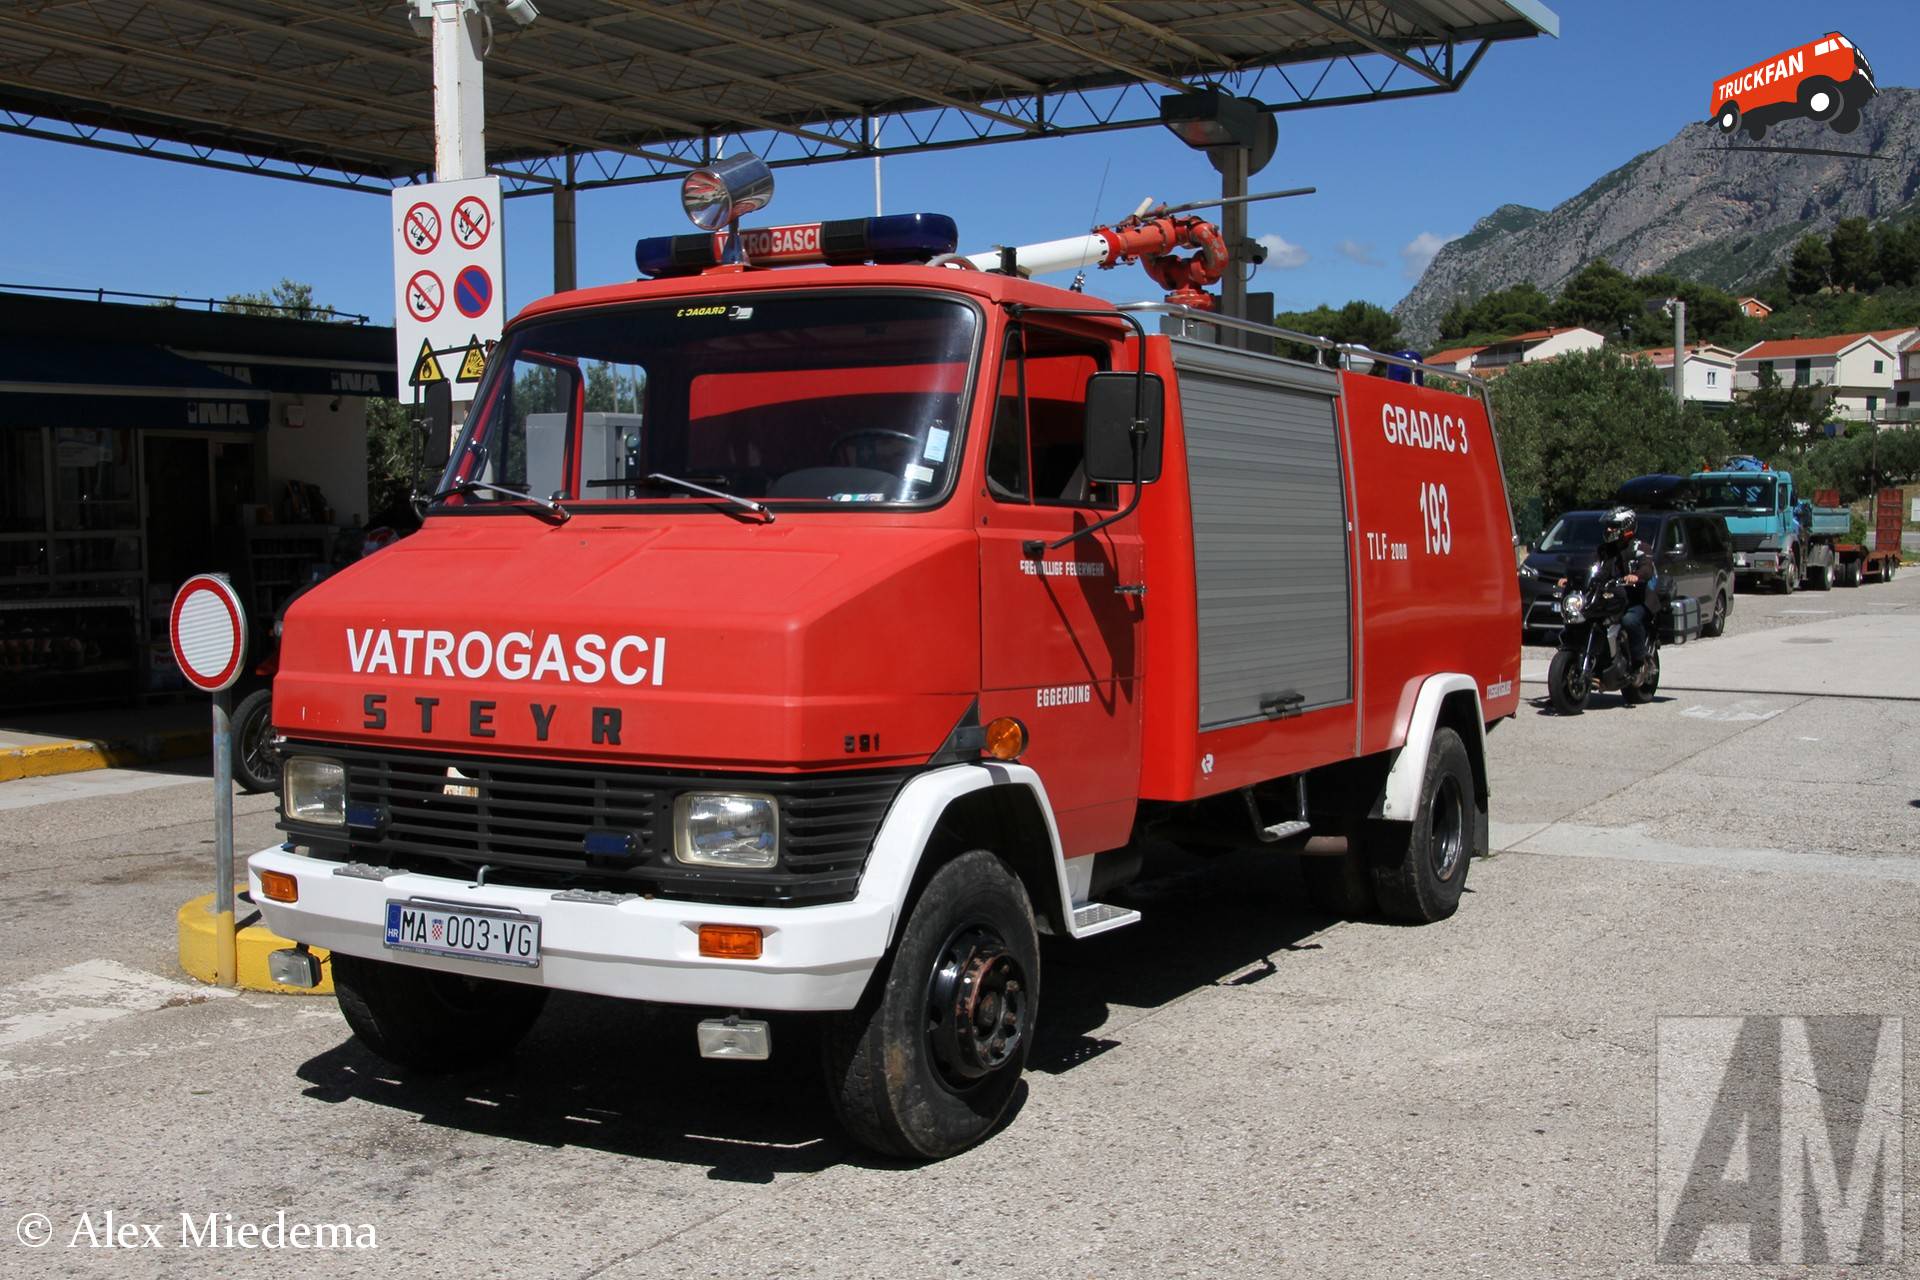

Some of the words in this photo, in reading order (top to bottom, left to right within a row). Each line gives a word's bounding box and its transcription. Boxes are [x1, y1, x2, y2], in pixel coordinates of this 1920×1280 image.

[718, 228, 821, 254] VTROGASCI
[1382, 403, 1456, 452] GRADAC
[1458, 417, 1469, 454] 3
[1420, 482, 1451, 555] 193
[1367, 532, 1387, 561] TLF
[1391, 543, 1408, 561] 2000
[346, 628, 666, 686] VATROGASCI
[363, 694, 622, 745] STEYR
[1037, 685, 1090, 708] EGGERDING
[387, 927, 399, 938] HR
[401, 910, 427, 943] MA
[446, 915, 532, 957] 003-VG
